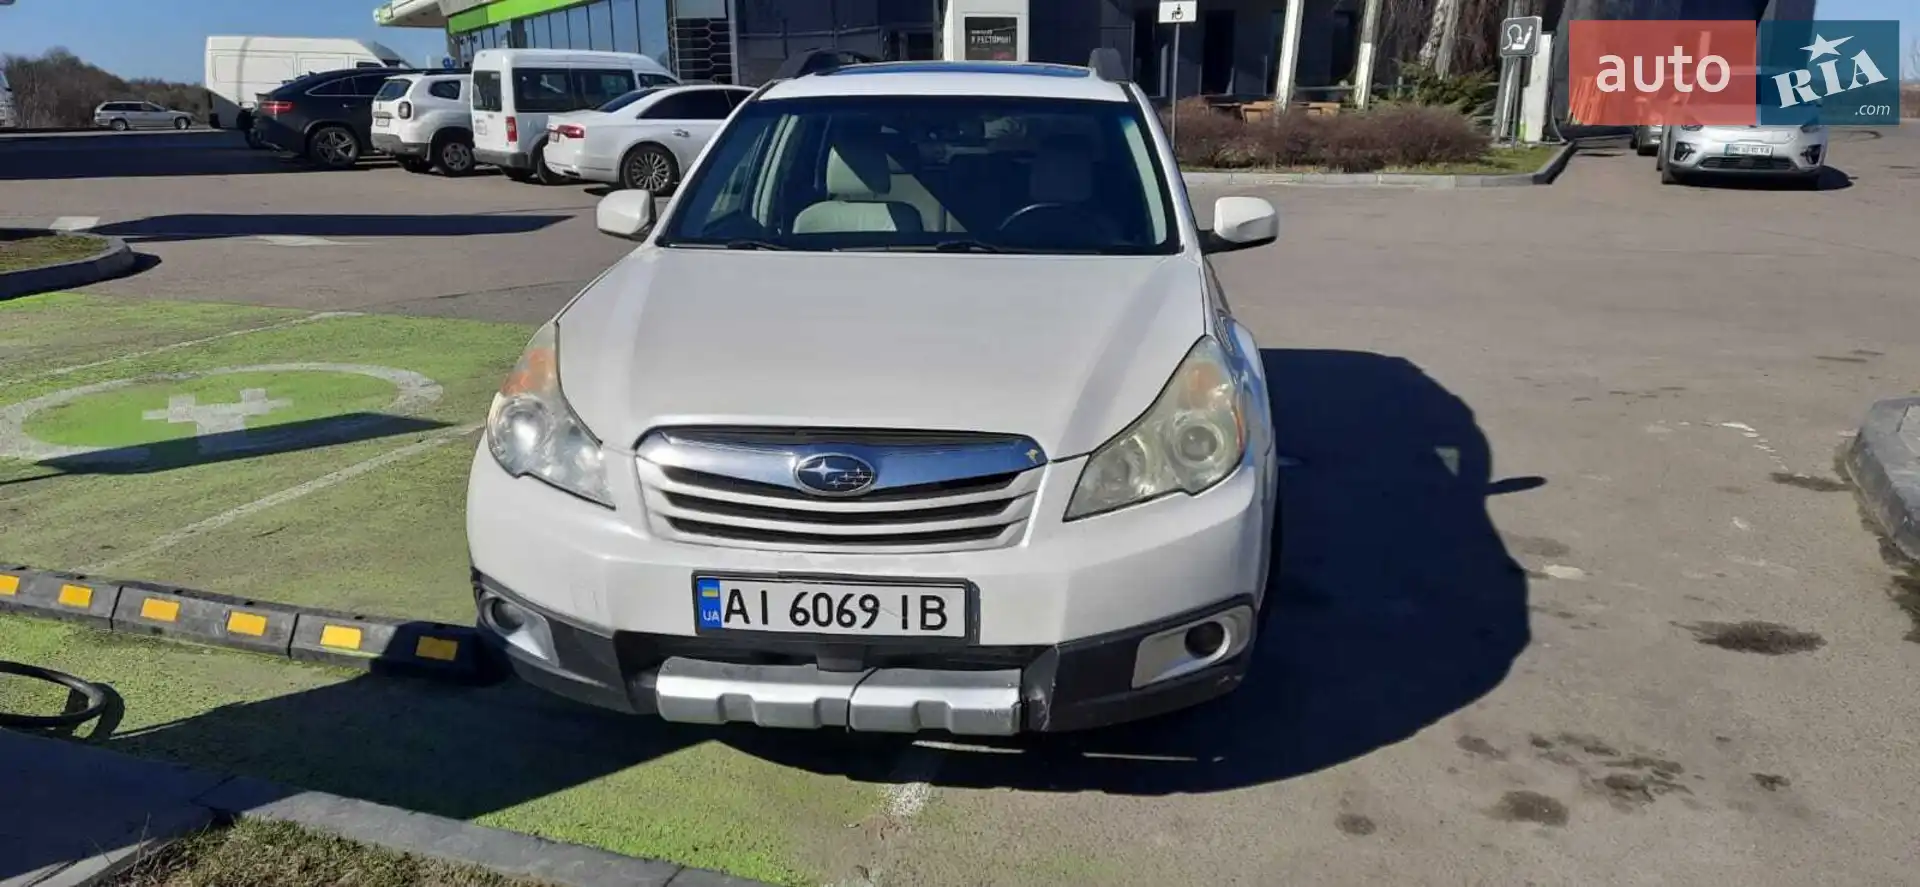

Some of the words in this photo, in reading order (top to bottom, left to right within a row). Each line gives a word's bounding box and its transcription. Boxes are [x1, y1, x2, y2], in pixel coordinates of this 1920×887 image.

[702, 608, 720, 622] UA
[723, 588, 768, 625] AI
[789, 591, 880, 629] 6069
[901, 594, 948, 631] IB
